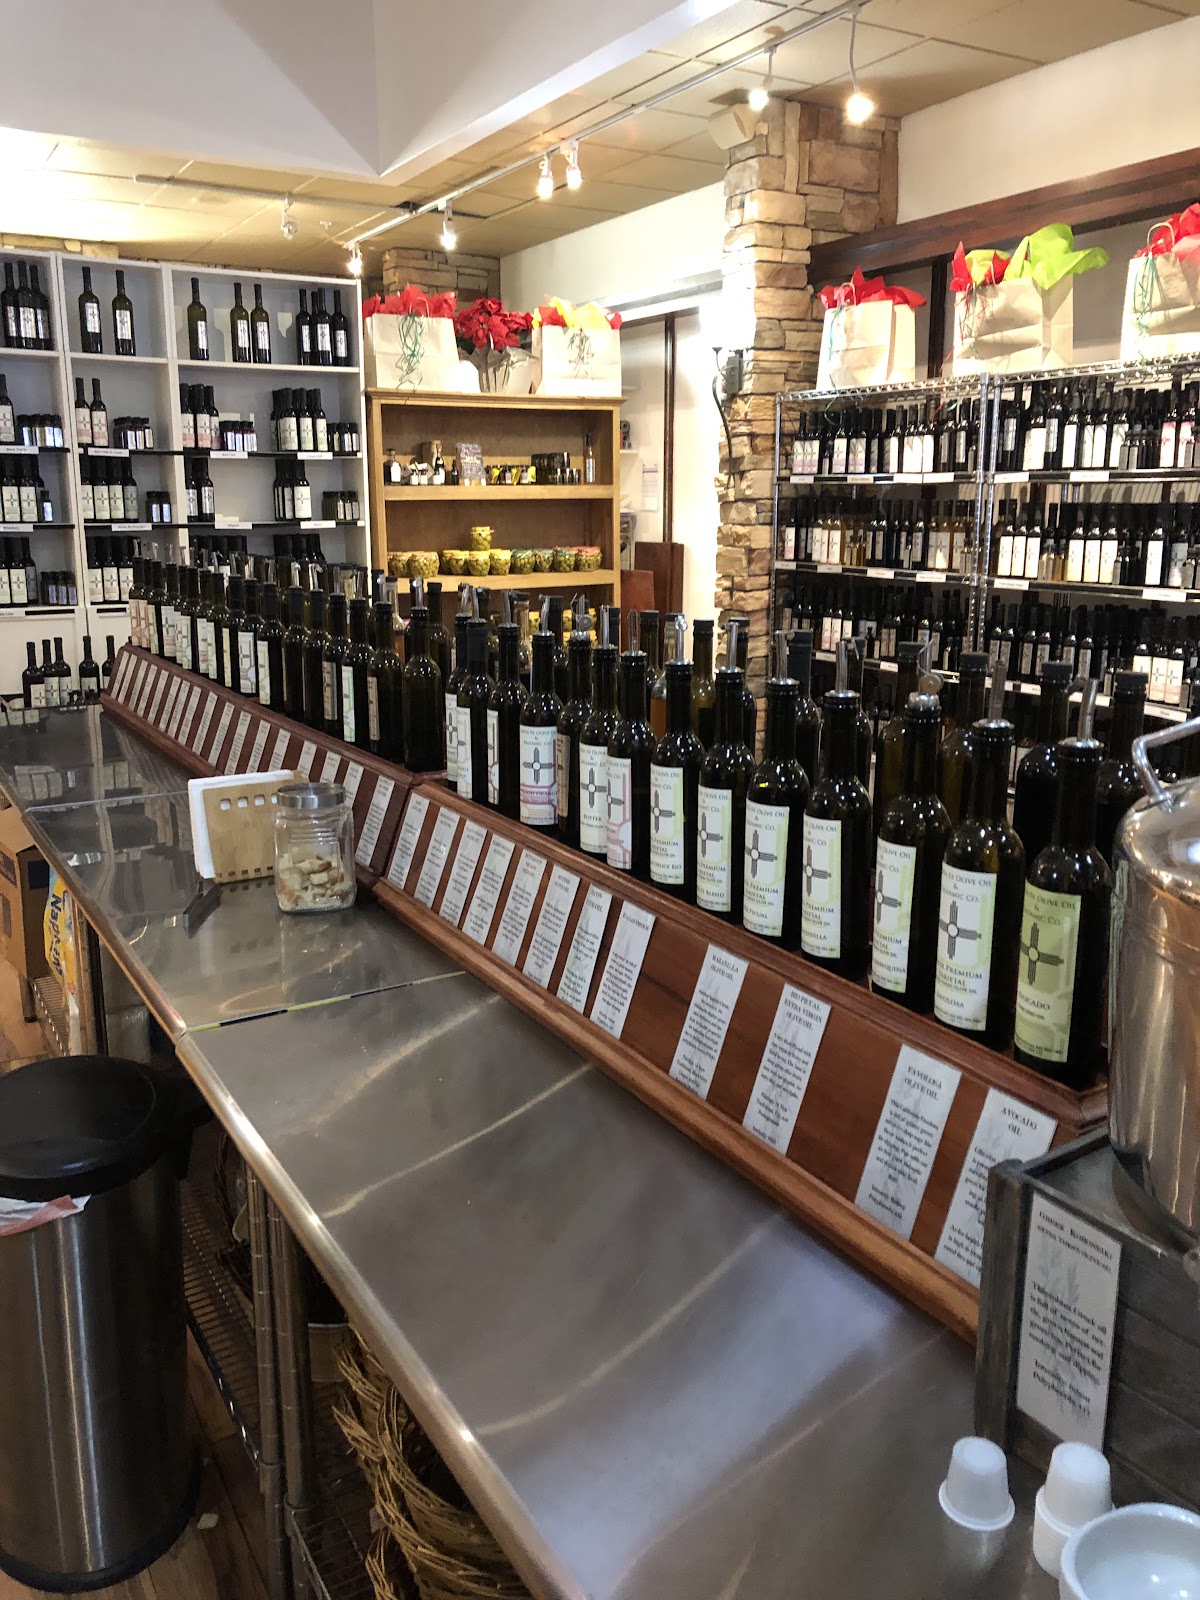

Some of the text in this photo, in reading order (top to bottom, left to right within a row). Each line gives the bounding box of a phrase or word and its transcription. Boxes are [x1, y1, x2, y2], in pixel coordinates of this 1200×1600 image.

[956, 874, 976, 885] OLIVE
[945, 964, 983, 980] PREMIUM
[904, 1077, 926, 1095] OLIVE
[1001, 1107, 1038, 1131] AVOCADO
[1008, 1123, 1022, 1137] OIL
